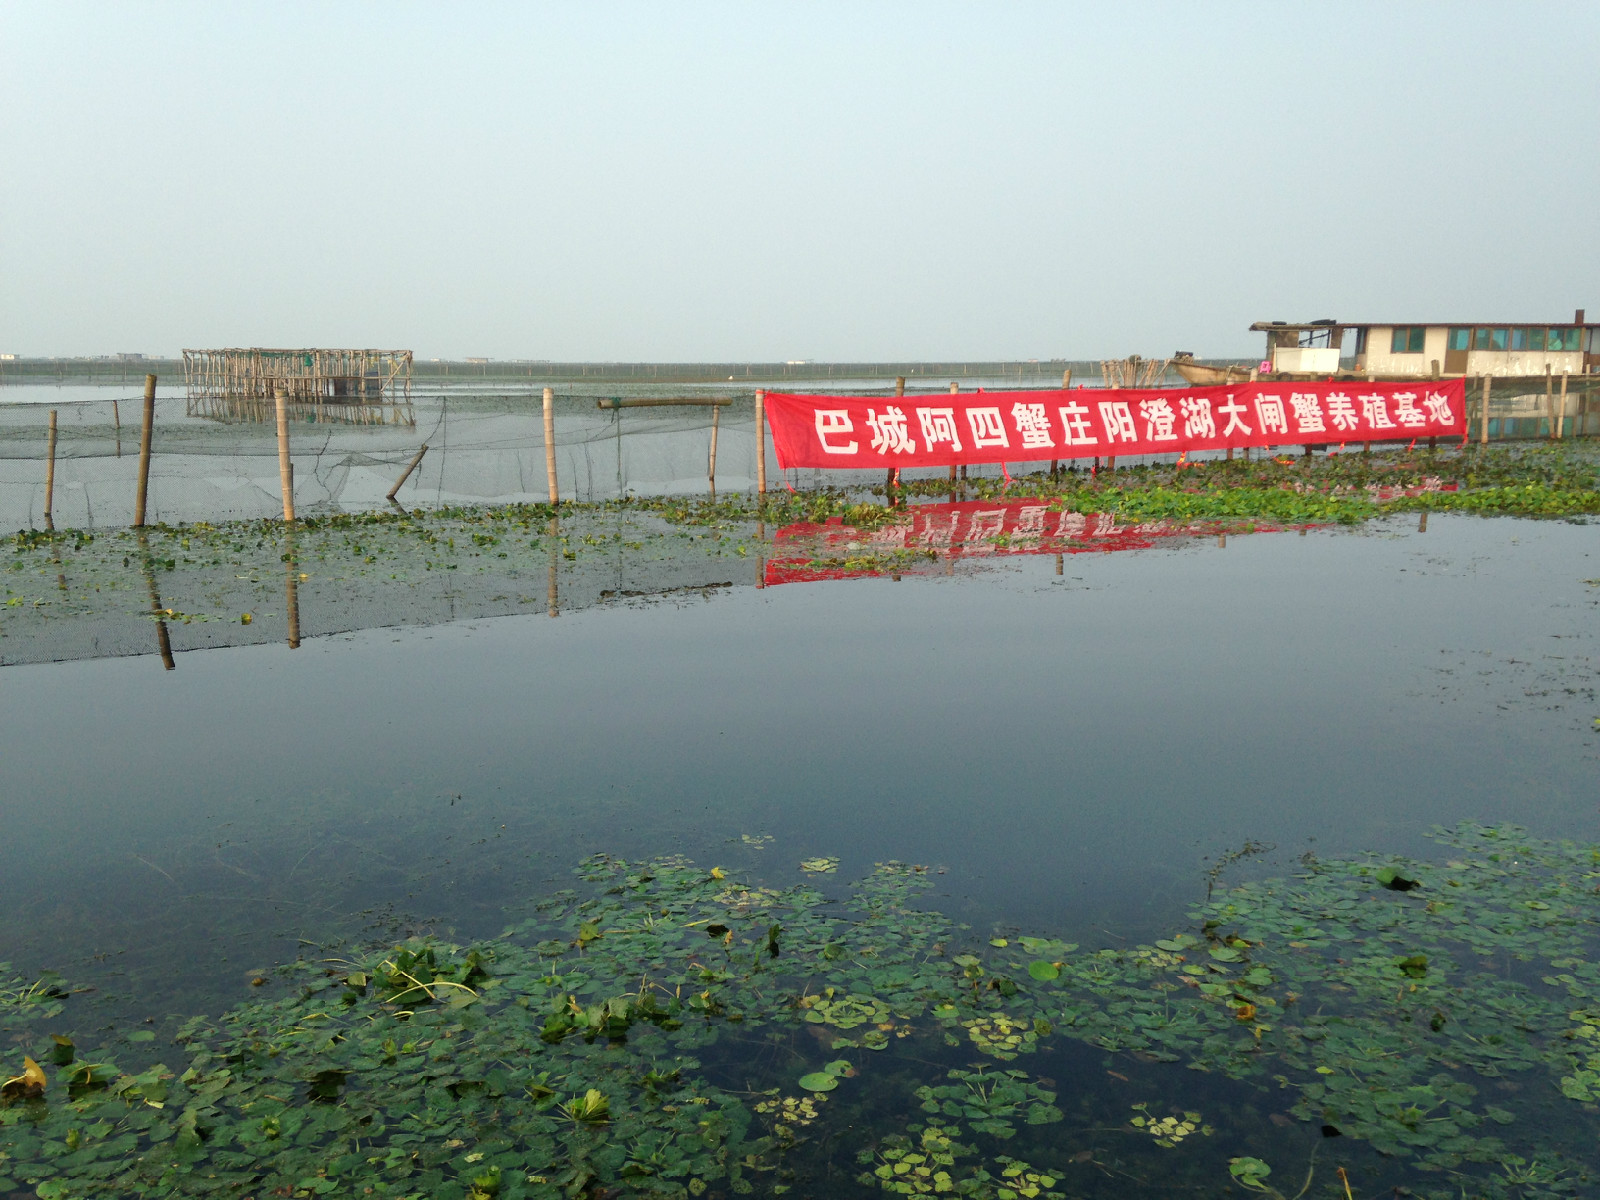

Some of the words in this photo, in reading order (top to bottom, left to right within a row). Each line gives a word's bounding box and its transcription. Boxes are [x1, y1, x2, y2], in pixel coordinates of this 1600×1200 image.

[814, 391, 1455, 455] 巴城阿四蟹庄阳澄湖大闸蟹养殖基地
